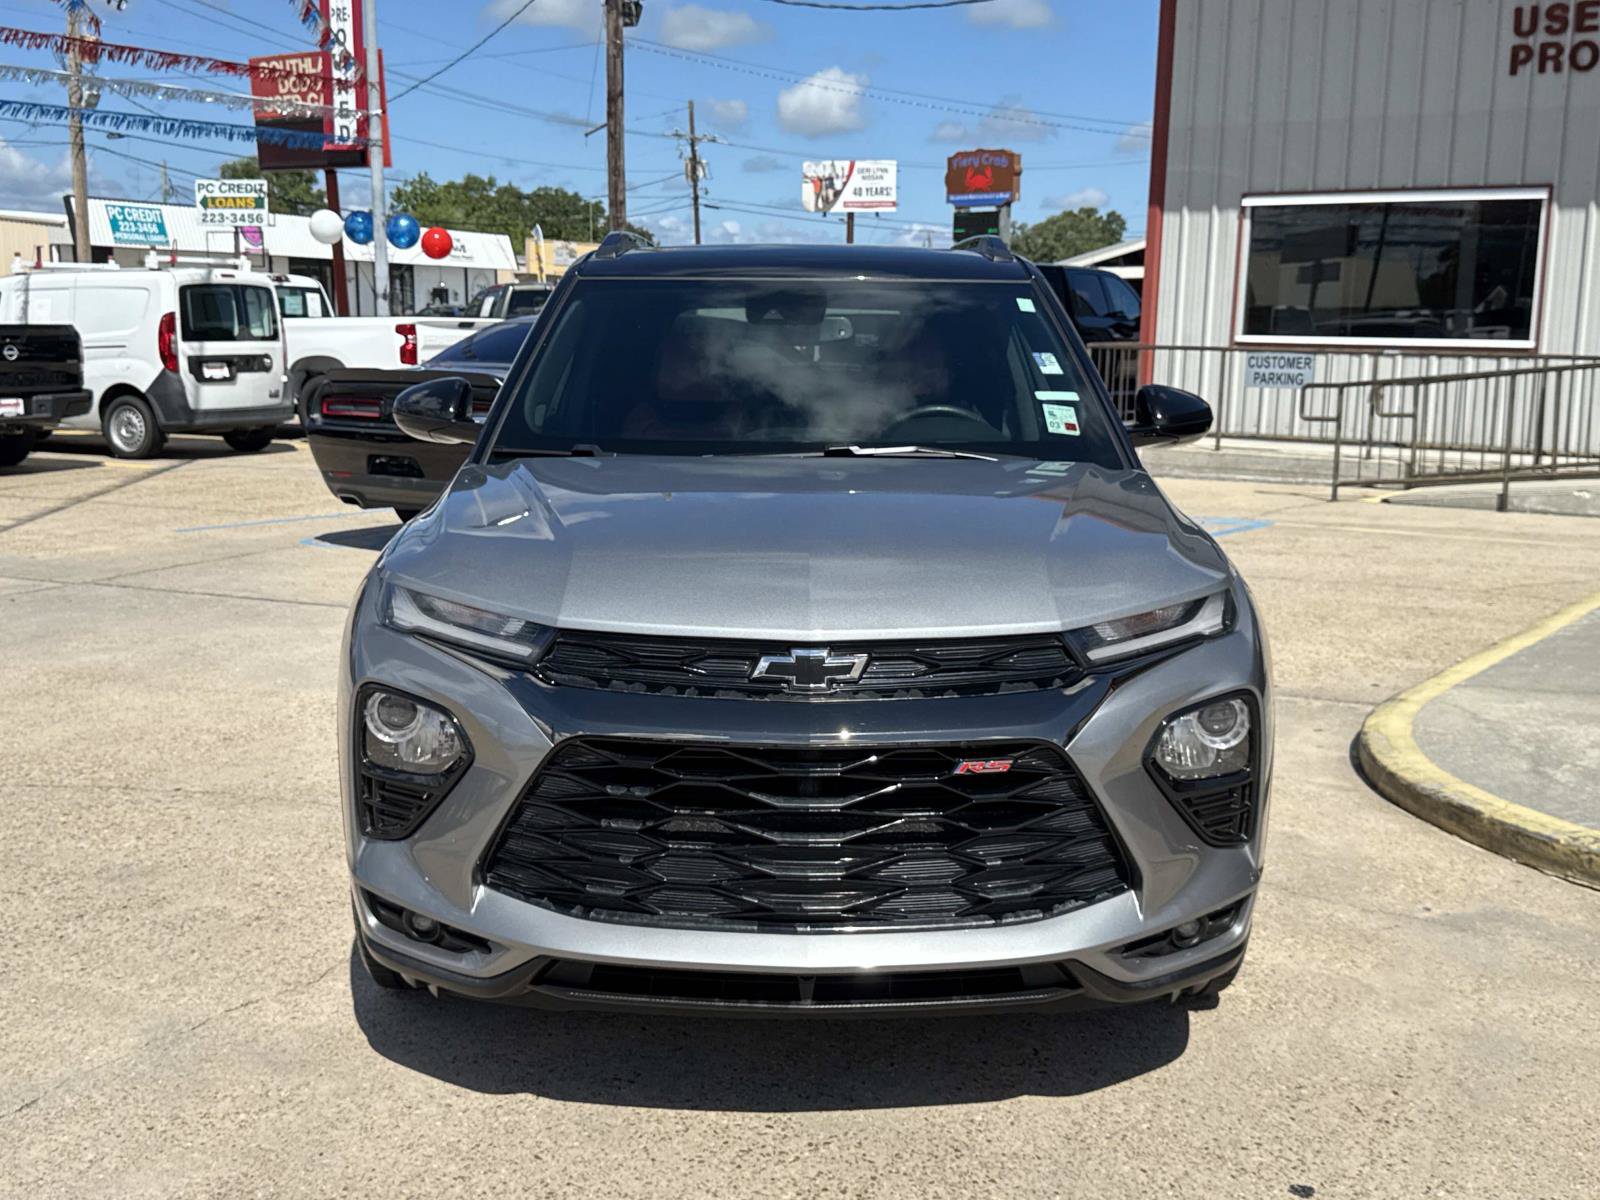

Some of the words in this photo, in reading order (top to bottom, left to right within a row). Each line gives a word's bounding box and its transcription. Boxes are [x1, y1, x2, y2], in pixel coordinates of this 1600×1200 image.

[1513, 0, 1600, 37] USE
[1508, 40, 1600, 76] PRO
[197, 183, 214, 193] PC
[218, 183, 264, 193] CREDIT
[207, 197, 256, 208] LOANS
[107, 206, 124, 220] PC
[124, 207, 163, 223] CREDIT
[201, 213, 264, 223] 223-3456
[1247, 355, 1312, 369] CUSTOMER
[1253, 372, 1304, 385] PARKING
[954, 760, 1012, 774] RS
